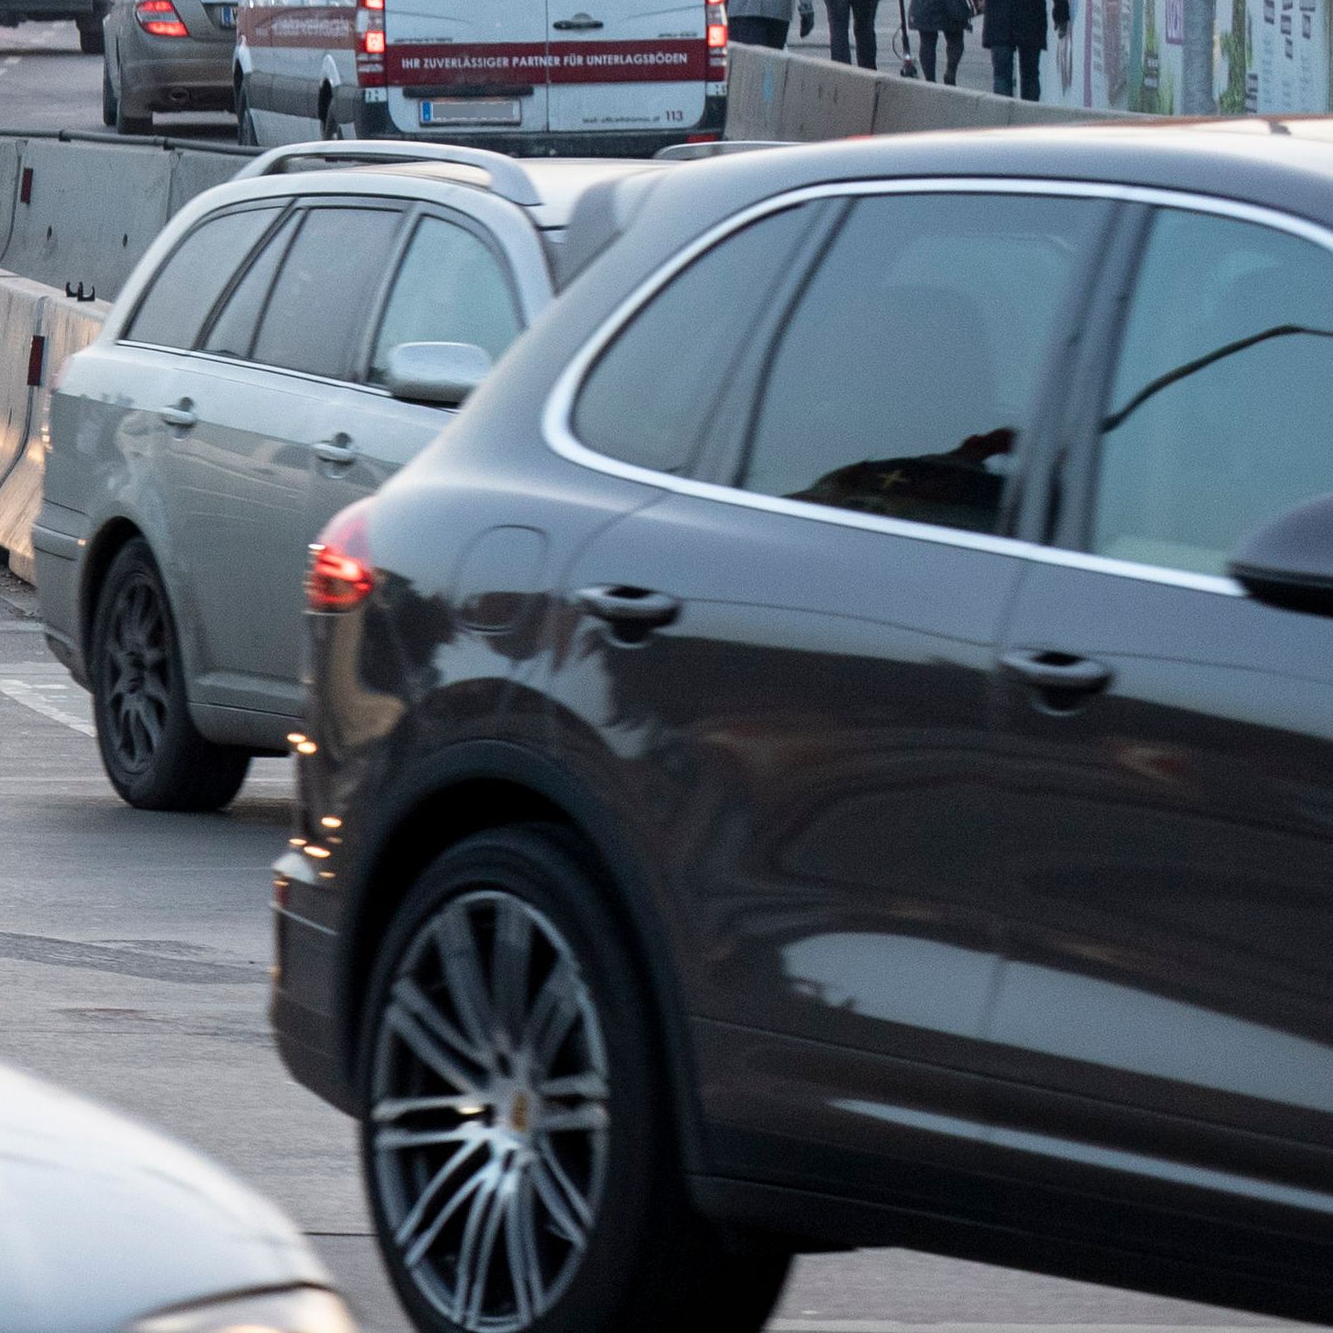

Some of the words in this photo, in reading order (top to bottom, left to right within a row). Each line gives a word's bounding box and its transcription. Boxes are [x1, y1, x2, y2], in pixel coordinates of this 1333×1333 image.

[401, 57, 421, 69] IHR
[423, 55, 510, 69] ZUVERLÄSSIGER
[512, 55, 561, 67] PARTNER
[563, 53, 584, 67] FÜR
[586, 51, 688, 66] UNTERLAGSBÖDEN
[665, 110, 684, 122] 113
